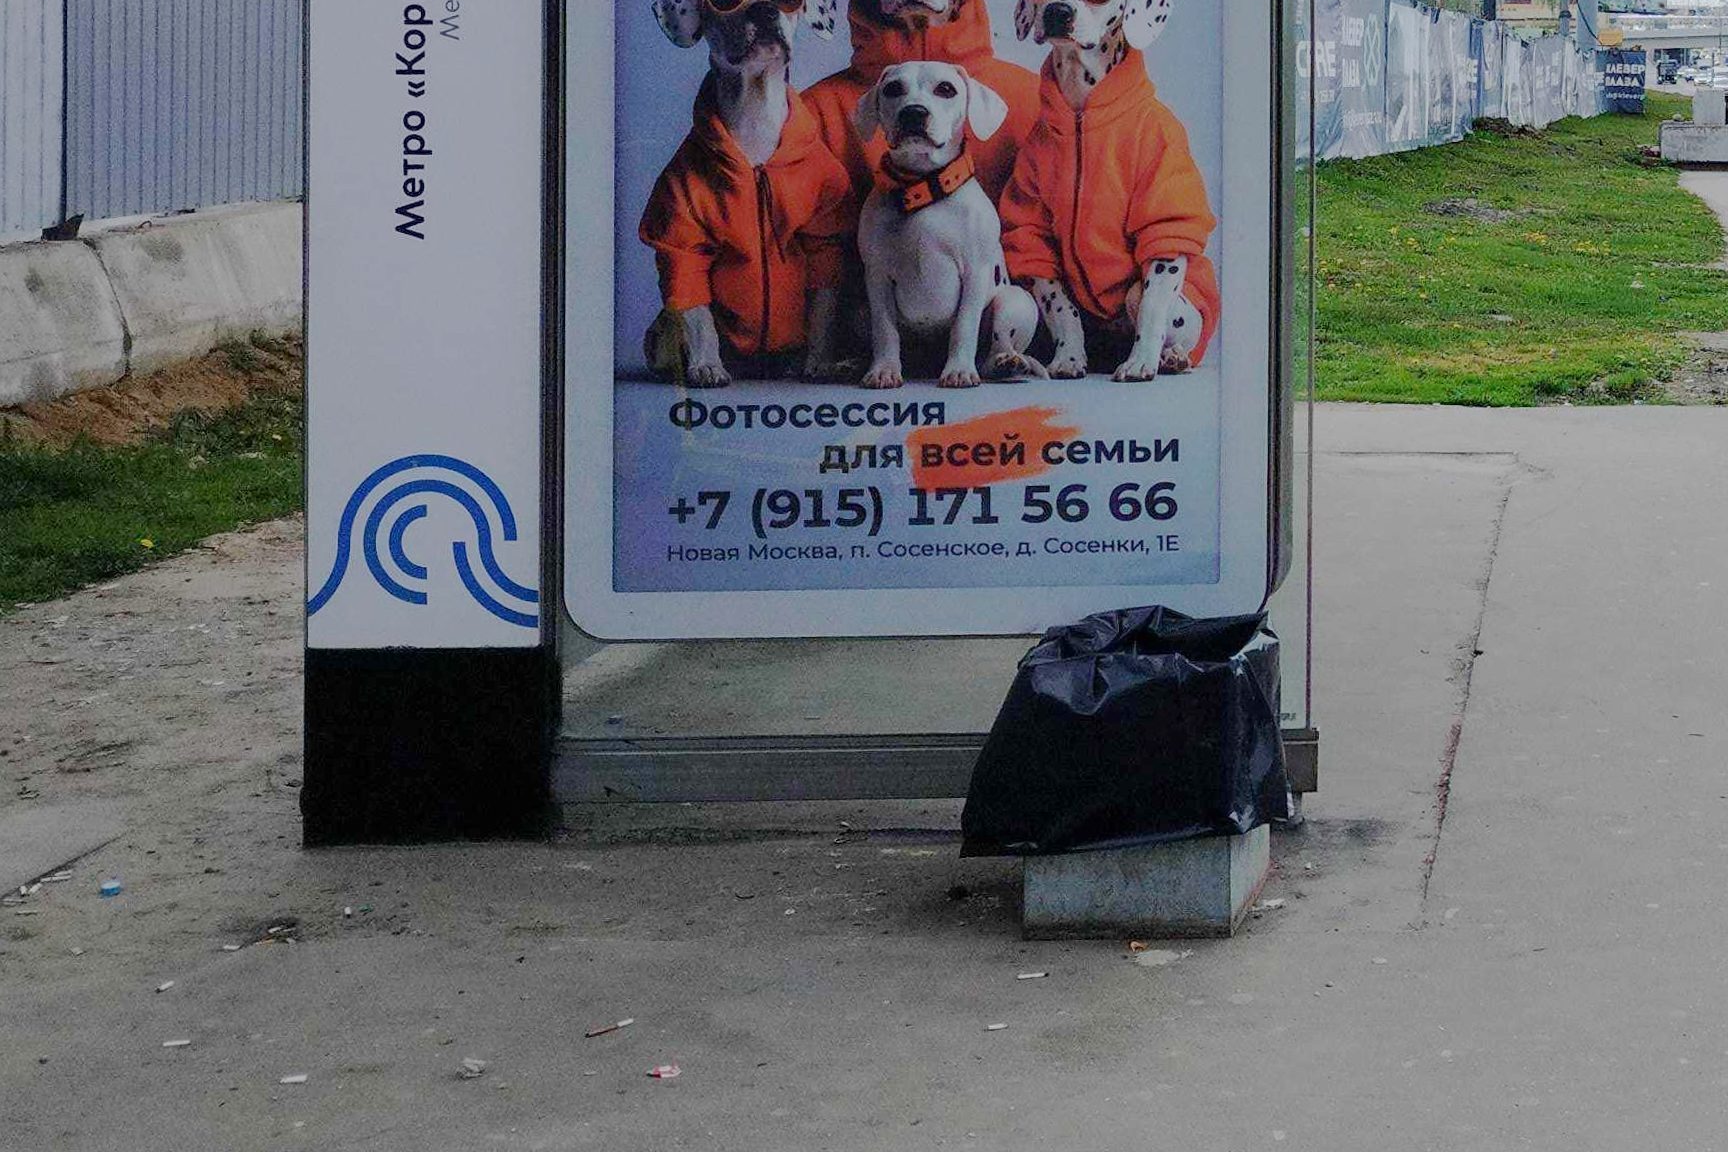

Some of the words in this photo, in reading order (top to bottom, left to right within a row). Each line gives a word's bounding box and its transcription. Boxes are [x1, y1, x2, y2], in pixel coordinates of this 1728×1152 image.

[395, 110, 433, 239] Метро
[668, 397, 945, 431] Фотосессия
[819, 444, 904, 474] для
[921, 433, 1025, 468] всей
[1041, 438, 1180, 466] семьи
[668, 490, 731, 530] +7
[751, 486, 884, 540] (915)
[907, 485, 999, 527] 171
[1020, 483, 1090, 524] 56
[1108, 481, 1178, 522] 66
[667, 544, 740, 562] Новая
[748, 543, 843, 562] Москва,
[850, 546, 870, 559] п.
[877, 540, 1010, 560] Сосенское,
[1015, 542, 1037, 558] д.
[1043, 536, 1151, 556] Сосенки,
